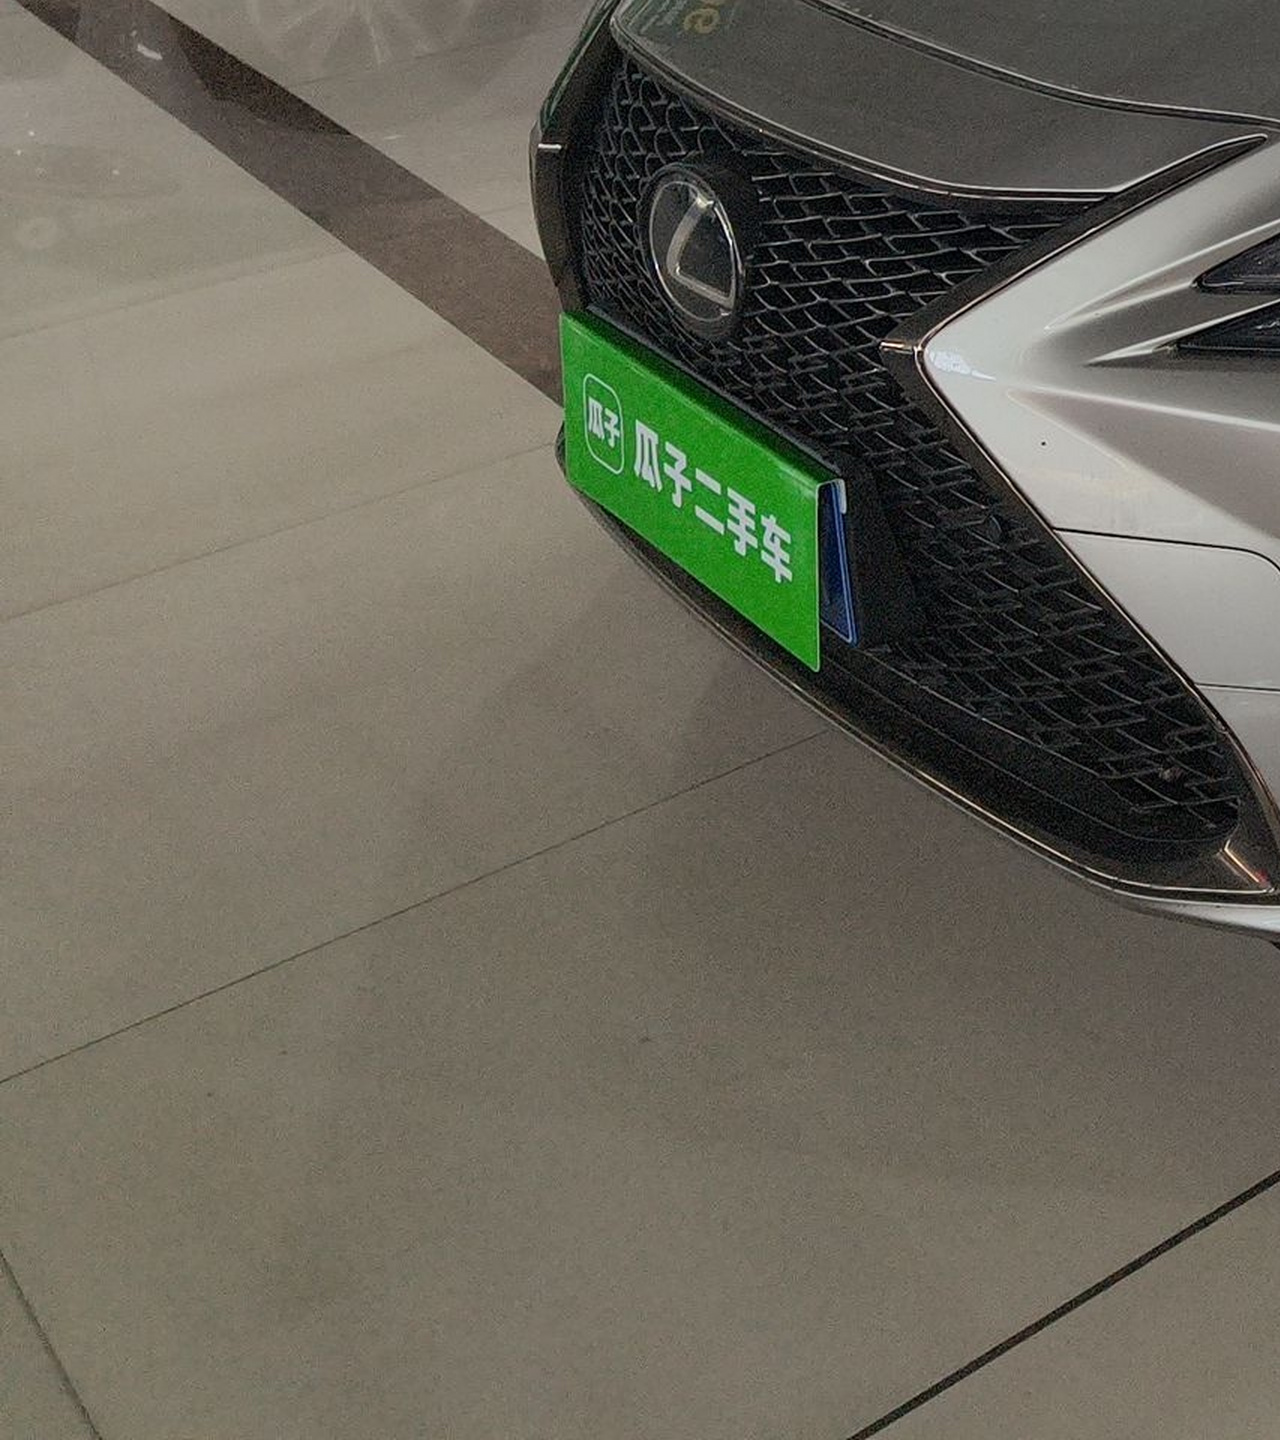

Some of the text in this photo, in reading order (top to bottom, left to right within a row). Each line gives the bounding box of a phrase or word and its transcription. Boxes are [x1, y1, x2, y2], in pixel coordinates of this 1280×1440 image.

[588, 396, 620, 448] 瓜子
[633, 419, 793, 584] 瓜子二手车
